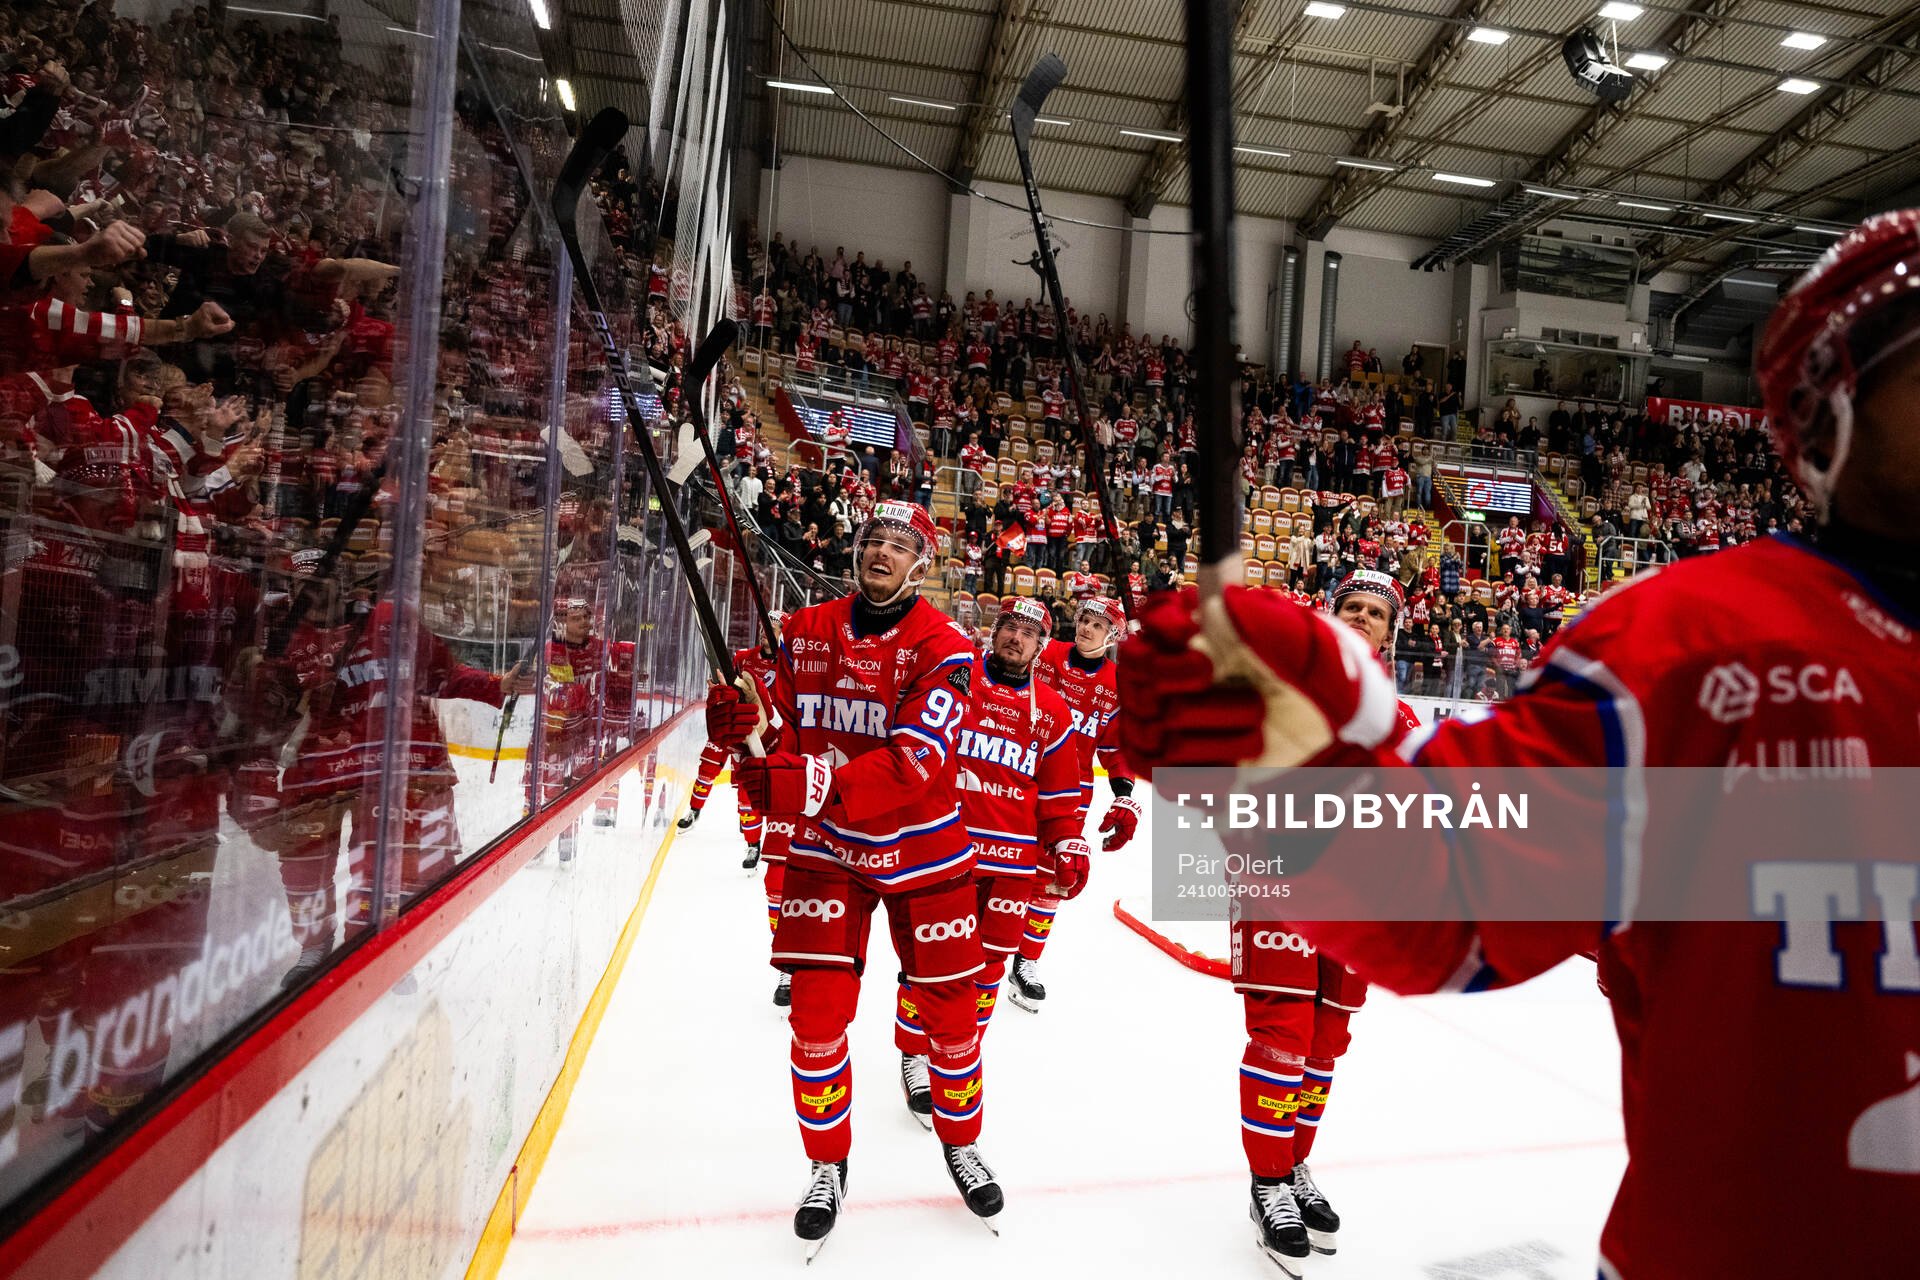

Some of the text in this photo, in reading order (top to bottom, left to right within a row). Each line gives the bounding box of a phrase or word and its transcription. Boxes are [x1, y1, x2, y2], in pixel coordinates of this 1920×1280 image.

[1550, 541, 1563, 552] 54
[807, 640, 831, 653] SCA
[1767, 664, 1863, 703] SCA
[1103, 689, 1118, 700] SCA
[982, 701, 1020, 718] HIGHCON
[995, 723, 1016, 735] NHC
[957, 729, 1038, 777] IMRÅ
[983, 781, 1025, 801] NHC
[781, 898, 846, 923] coop
[915, 914, 977, 943] coop
[803, 1089, 844, 1106] SUNDFRAKT
